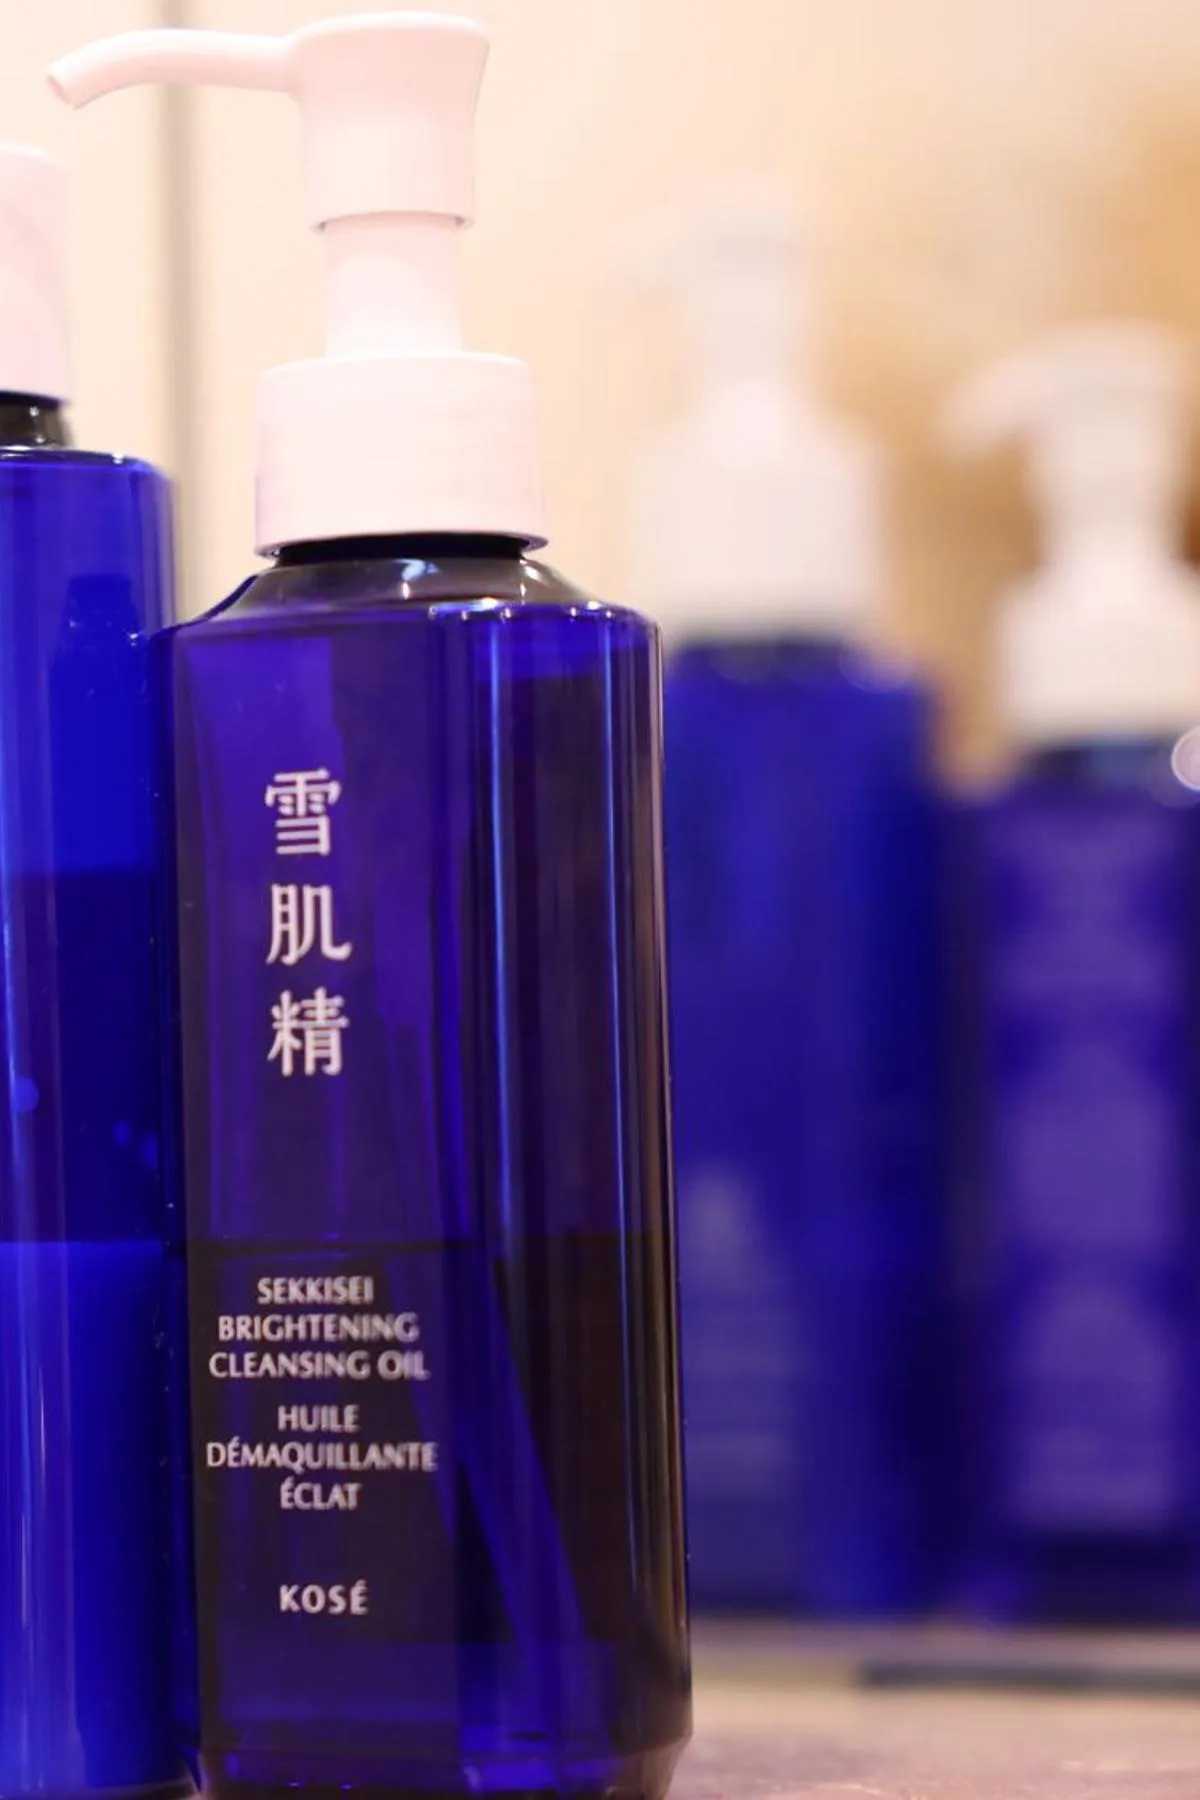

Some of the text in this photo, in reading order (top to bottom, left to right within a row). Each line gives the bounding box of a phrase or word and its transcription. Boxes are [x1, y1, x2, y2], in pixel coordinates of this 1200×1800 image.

[264, 768, 352, 1077] 雪肌精
[257, 1276, 373, 1304] SEKKISEI
[218, 1313, 420, 1342] BRIGHTENING
[208, 1350, 431, 1380] CLEANSING OIL
[277, 1404, 357, 1432] HUILE
[206, 1436, 438, 1474] DÉMAQUILLANTE
[280, 1476, 360, 1510] ÉCLAT
[279, 1579, 366, 1615] KOSÉ
